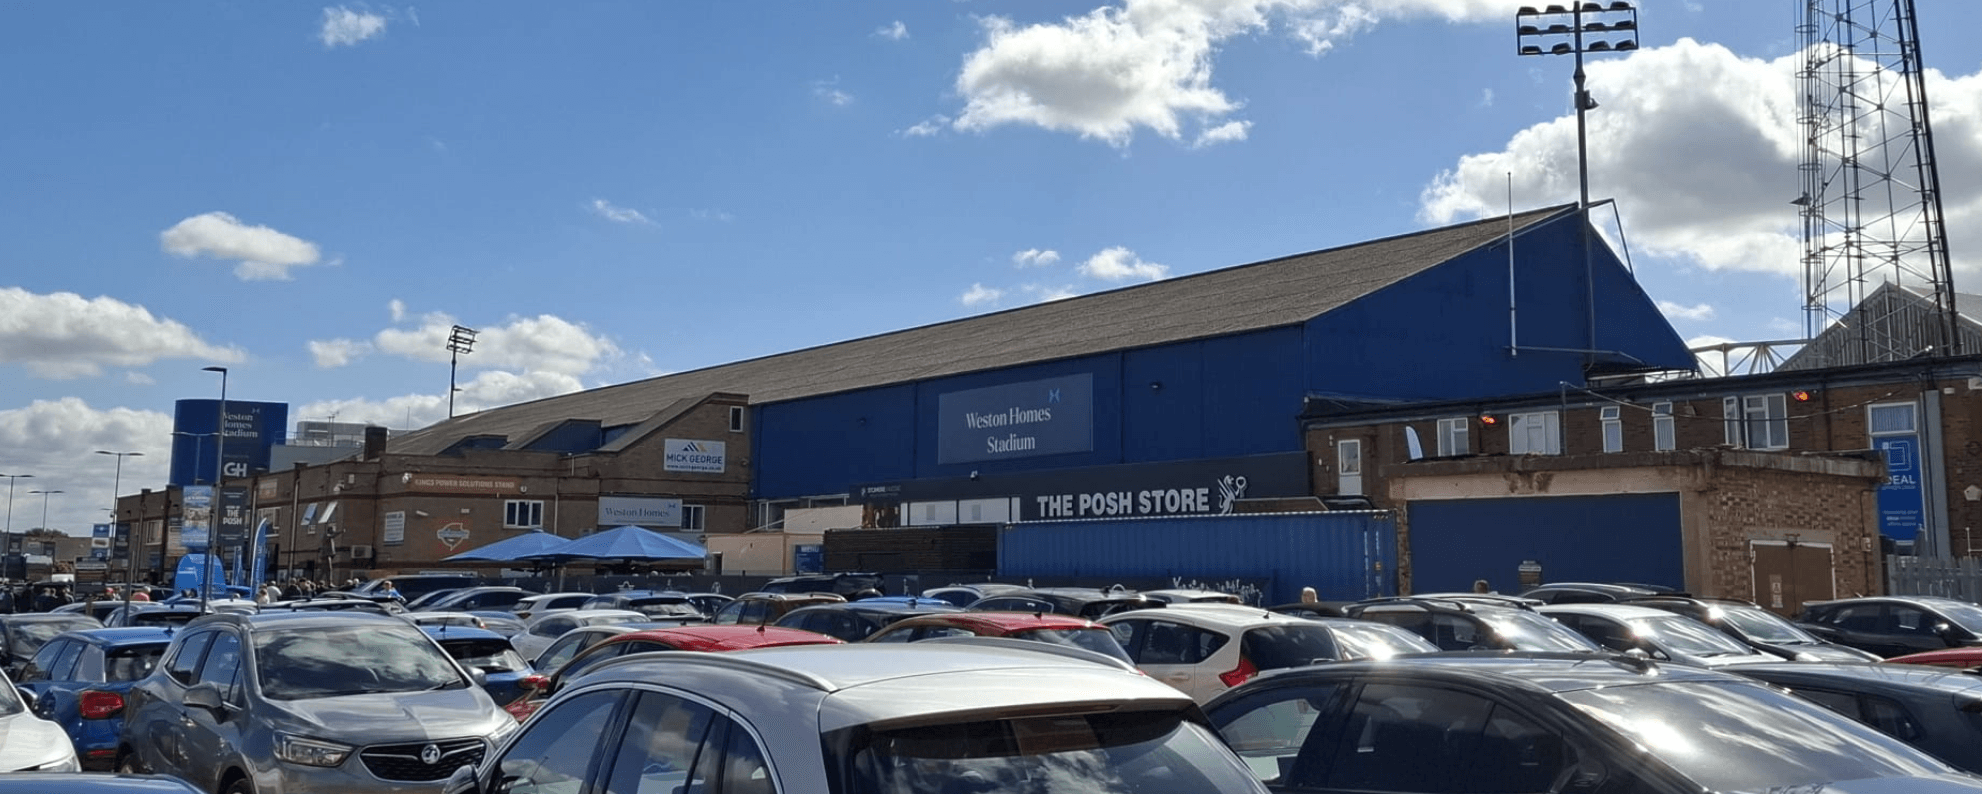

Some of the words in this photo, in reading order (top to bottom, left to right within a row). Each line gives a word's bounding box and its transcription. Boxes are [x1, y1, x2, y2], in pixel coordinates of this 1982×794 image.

[966, 411, 1007, 429] Weston
[1009, 407, 1051, 425] Homes
[987, 433, 1035, 454] Stadium
[666, 453, 687, 463] MICK
[689, 454, 722, 465] GEORGE
[224, 462, 247, 478] GH
[436, 479, 457, 487] POWER
[459, 480, 493, 488] SOLUTIONS
[495, 481, 515, 489] STAND
[1037, 495, 1073, 517] THE
[1079, 491, 1132, 515] POSH
[1139, 487, 1210, 514] STORE
[605, 507, 637, 517] Weston
[639, 507, 670, 517] Homes
[222, 517, 242, 525] POSH
